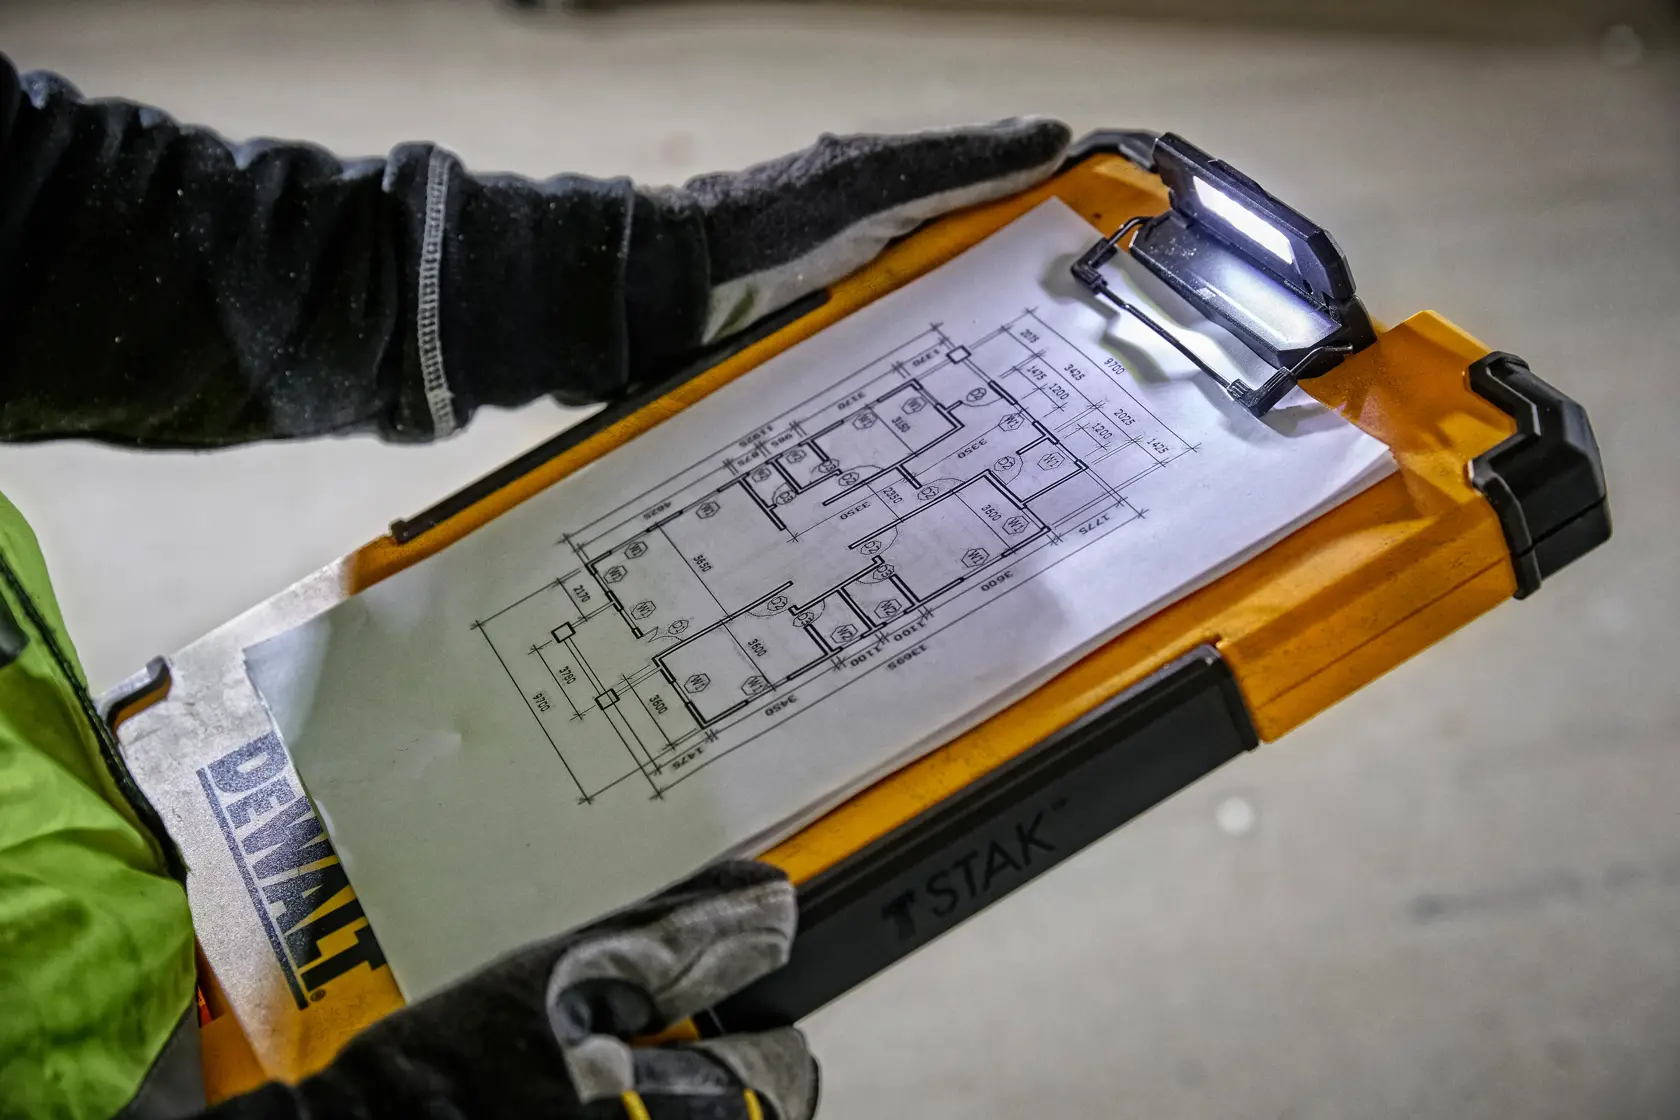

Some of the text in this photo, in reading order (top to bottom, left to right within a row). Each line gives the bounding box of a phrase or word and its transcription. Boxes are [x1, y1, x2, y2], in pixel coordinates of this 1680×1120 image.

[1026, 365, 1048, 381] 1475
[1064, 363, 1086, 382] 3425
[1104, 358, 1126, 376] 9700
[1049, 383, 1070, 400] 1200
[1005, 413, 1020, 428] W1
[1113, 408, 1136, 426] 2025
[1091, 422, 1113, 440] 1200
[957, 438, 988, 459] 3350
[1146, 438, 1169, 454] 1425
[999, 456, 1014, 470] D2
[1043, 453, 1059, 468] W1
[841, 473, 857, 486] D2
[883, 487, 904, 504] 2350
[921, 487, 937, 500] D2
[839, 501, 871, 520] 3350
[981, 504, 1002, 522] 3600
[1009, 517, 1024, 532] W1
[1079, 515, 1110, 536] 1775
[864, 541, 878, 554] D2
[693, 554, 712, 573] 5650
[968, 549, 983, 565] W1
[878, 564, 892, 578] D3
[980, 570, 1014, 592] 3600
[573, 585, 591, 603] 2170
[637, 603, 651, 617] W1
[771, 596, 784, 610] D2
[881, 600, 896, 616] W2
[838, 625, 852, 641] W2
[893, 621, 927, 642] 1100
[748, 638, 767, 657] 3600
[850, 646, 883, 667] 1100
[559, 666, 576, 685] 3780
[690, 675, 705, 690] W1
[748, 676, 763, 692] W1
[533, 692, 550, 712] 9700
[649, 694, 668, 715] 3600
[764, 694, 797, 717] 3450
[672, 748, 703, 769] 1475
